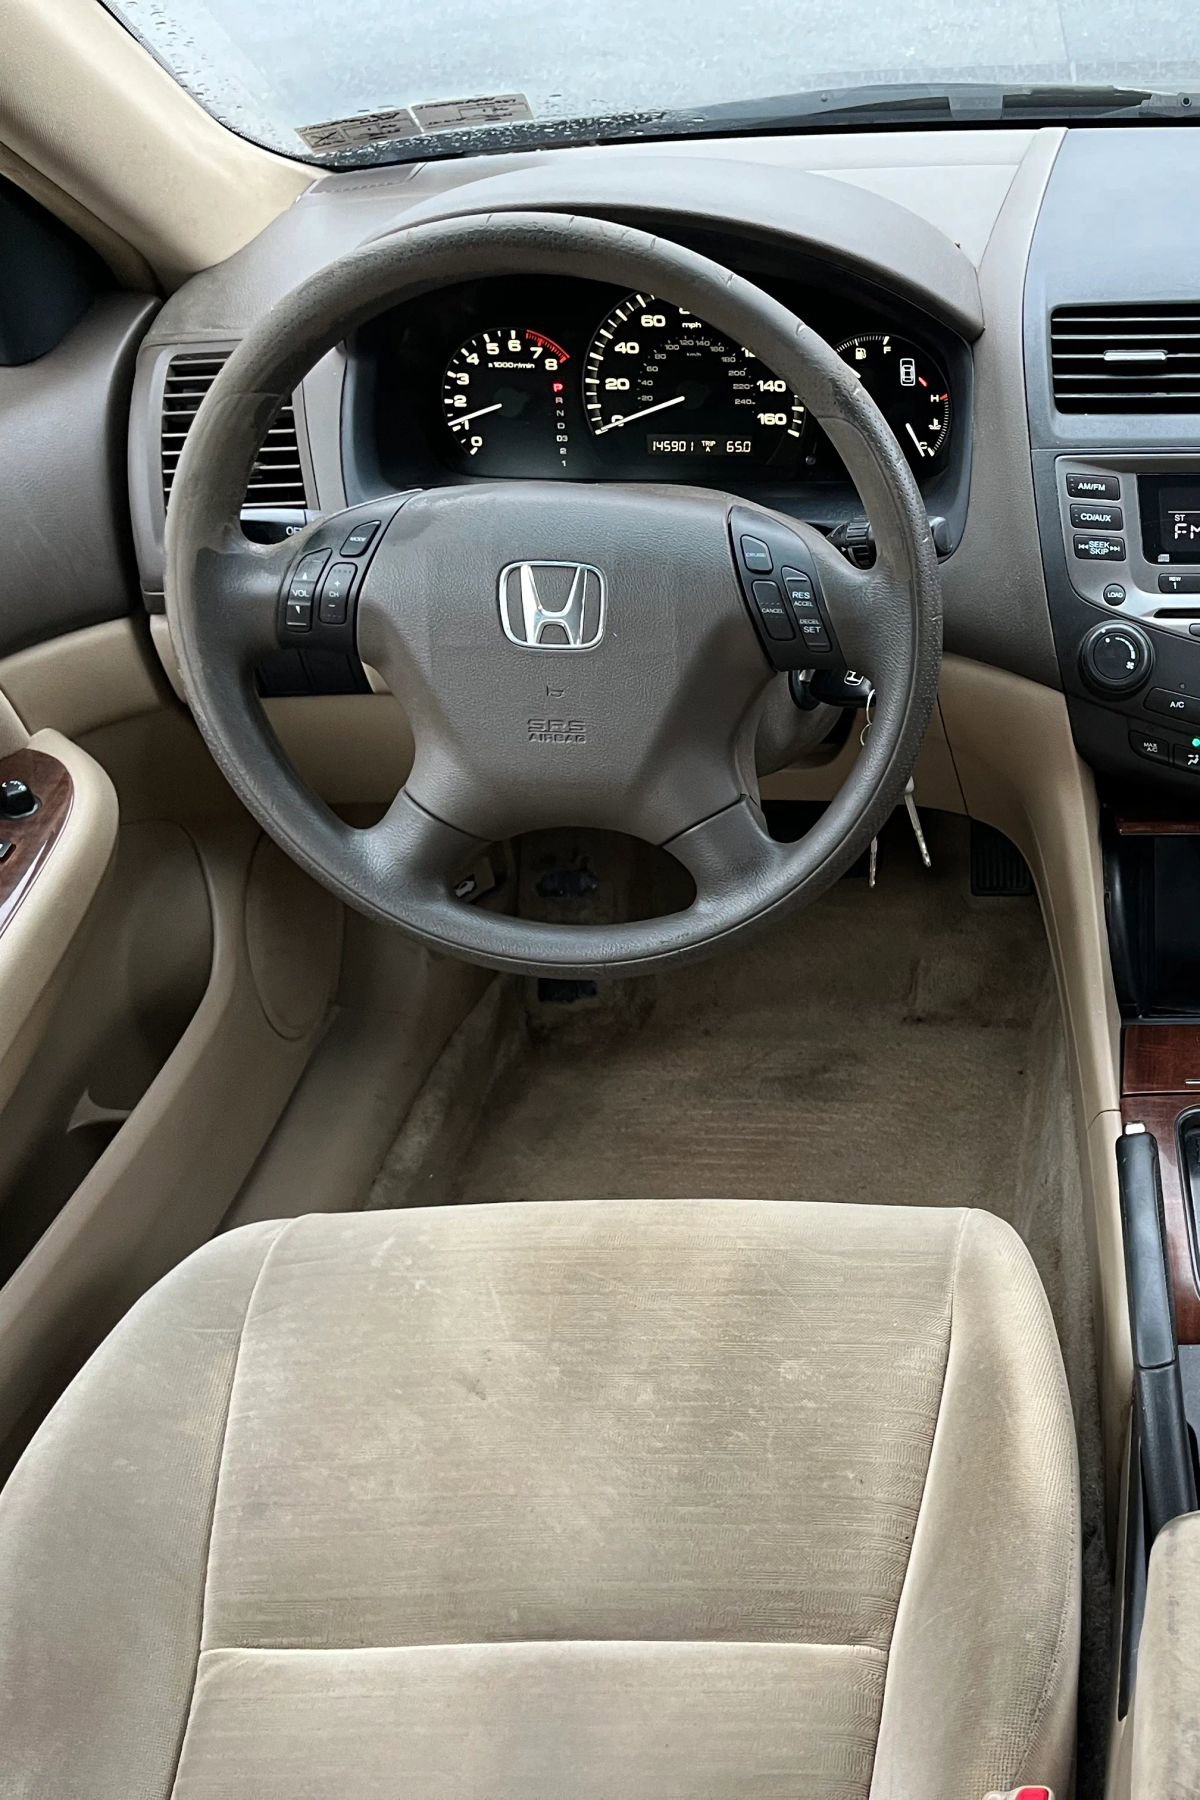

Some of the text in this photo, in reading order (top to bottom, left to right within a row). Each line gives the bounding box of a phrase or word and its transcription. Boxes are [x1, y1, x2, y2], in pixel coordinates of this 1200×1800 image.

[641, 315, 666, 327] 60
[682, 321, 702, 329] mph
[486, 343, 499, 355] 5
[508, 340, 521, 352] 6
[614, 342, 640, 354] 40
[883, 346, 892, 354] F
[530, 346, 543, 358] 7
[466, 353, 479, 366] 4
[545, 358, 558, 370] 8
[457, 372, 470, 385] 3
[604, 377, 630, 390] 20
[553, 383, 563, 393] P
[756, 380, 787, 392] 140
[453, 395, 467, 408] 2
[555, 396, 564, 404] R
[930, 394, 940, 403] H
[756, 412, 787, 425] 160
[557, 422, 565, 430] D
[470, 436, 483, 447] 0
[652, 440, 694, 453] 145901
[559, 447, 567, 455] 2
[1078, 482, 1106, 491] AM/FM
[1080, 512, 1111, 522] CD/AUX
[1174, 514, 1186, 522] ST
[1088, 541, 1110, 549] SEEK
[1089, 547, 1109, 555] SKIP
[1172, 582, 1177, 590] 1
[792, 591, 811, 600] RES
[803, 626, 821, 634] SET
[1170, 701, 1185, 709] A/C
[527, 718, 586, 733] SRS
[528, 733, 586, 745] AIRBAG
